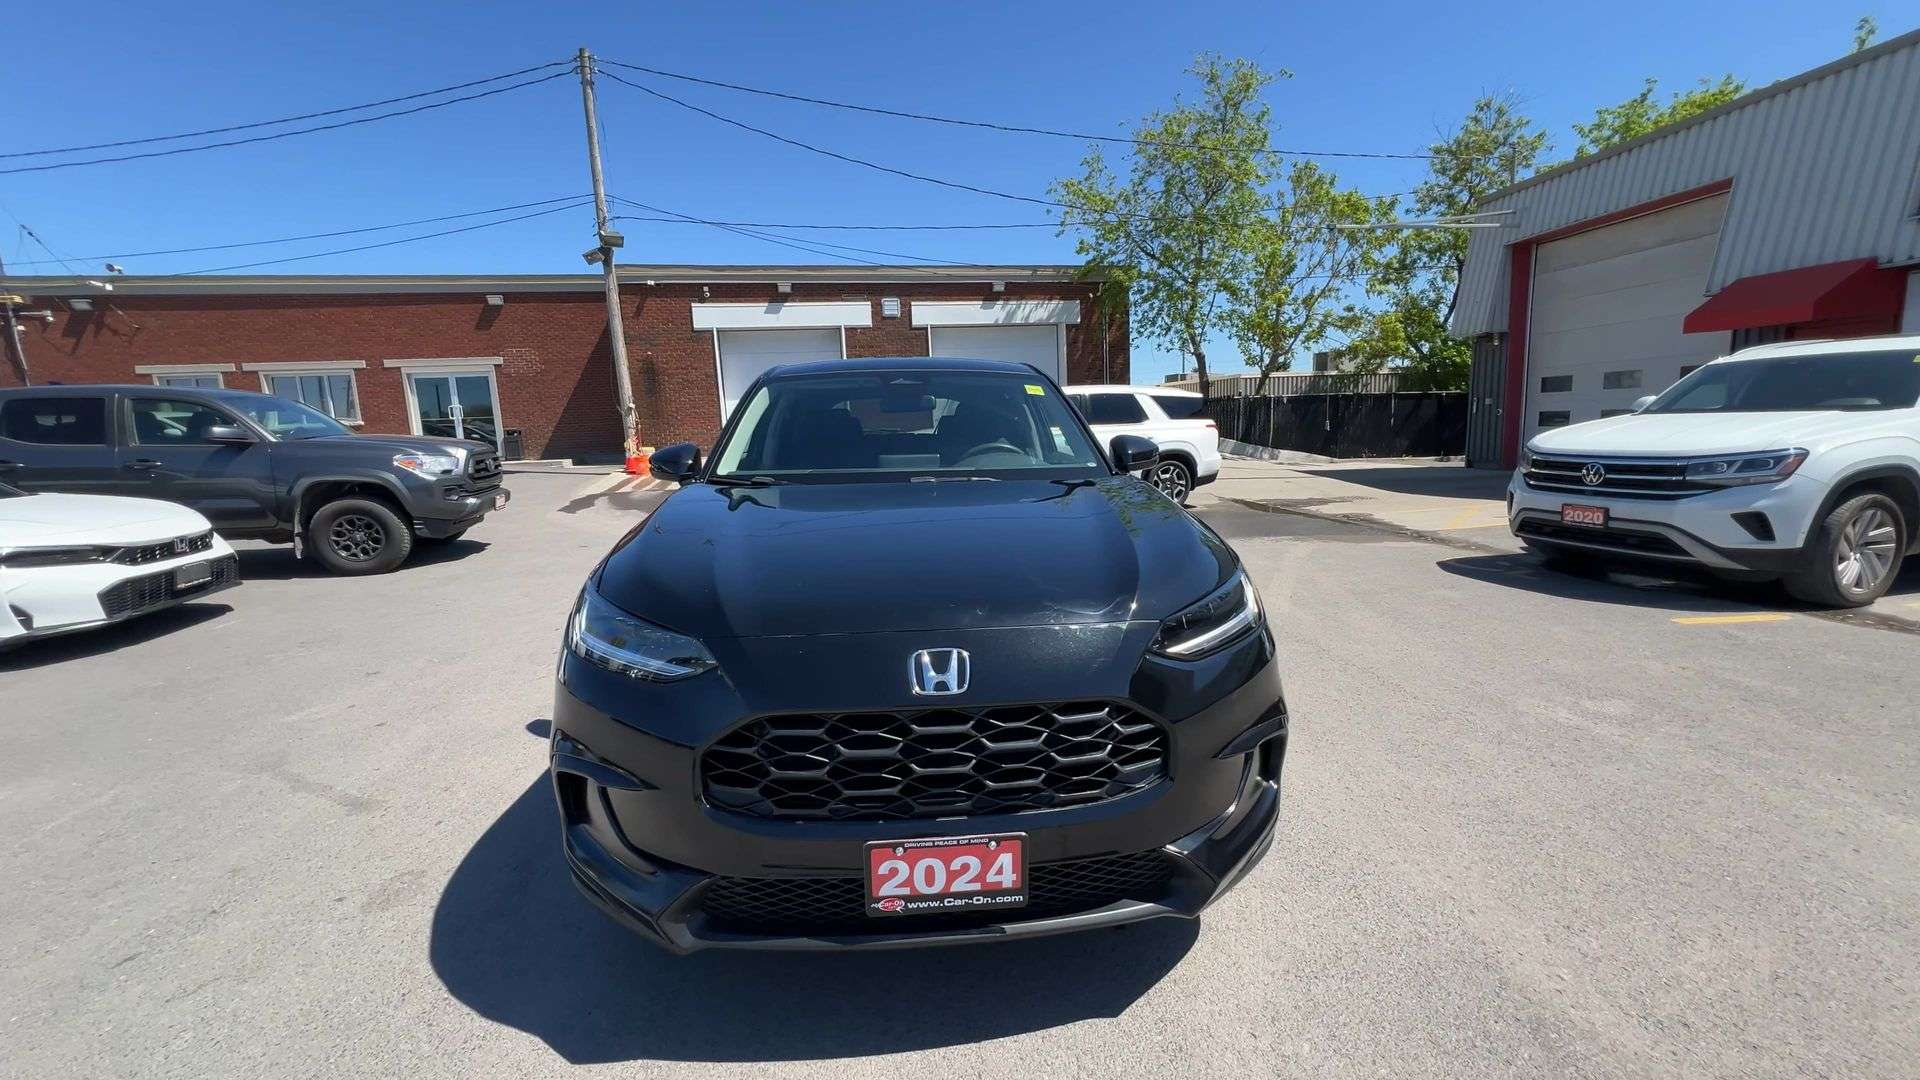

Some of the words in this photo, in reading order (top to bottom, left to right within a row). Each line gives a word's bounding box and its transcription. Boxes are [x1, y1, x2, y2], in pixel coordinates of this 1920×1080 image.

[1565, 509, 1604, 524] 2020
[878, 852, 1017, 897] 2024
[907, 895, 1024, 909] www.Car-On.com
